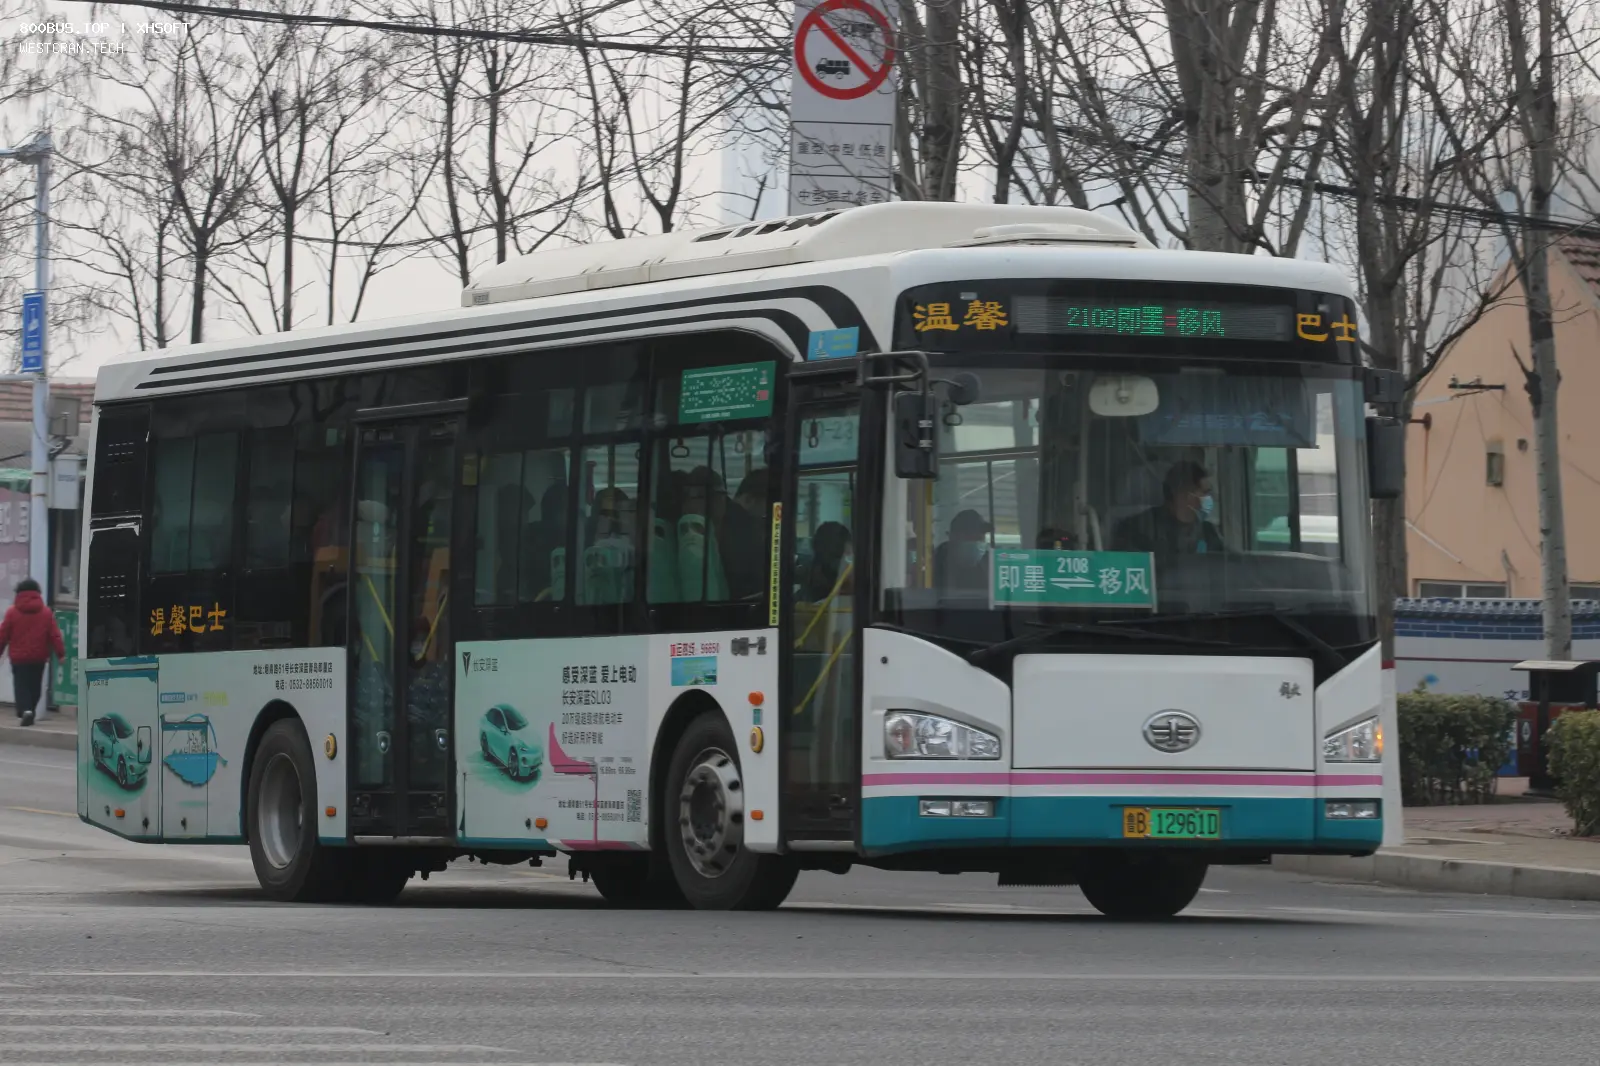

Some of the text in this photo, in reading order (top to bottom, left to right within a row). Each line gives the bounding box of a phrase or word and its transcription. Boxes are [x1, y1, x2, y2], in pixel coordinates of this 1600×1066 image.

[912, 299, 1008, 332] 温馨
[1296, 313, 1357, 342] 巴士
[998, 565, 1149, 595] 即墨 移风
[1057, 557, 1089, 574] 2108
[150, 602, 227, 637] 温馨巴士
